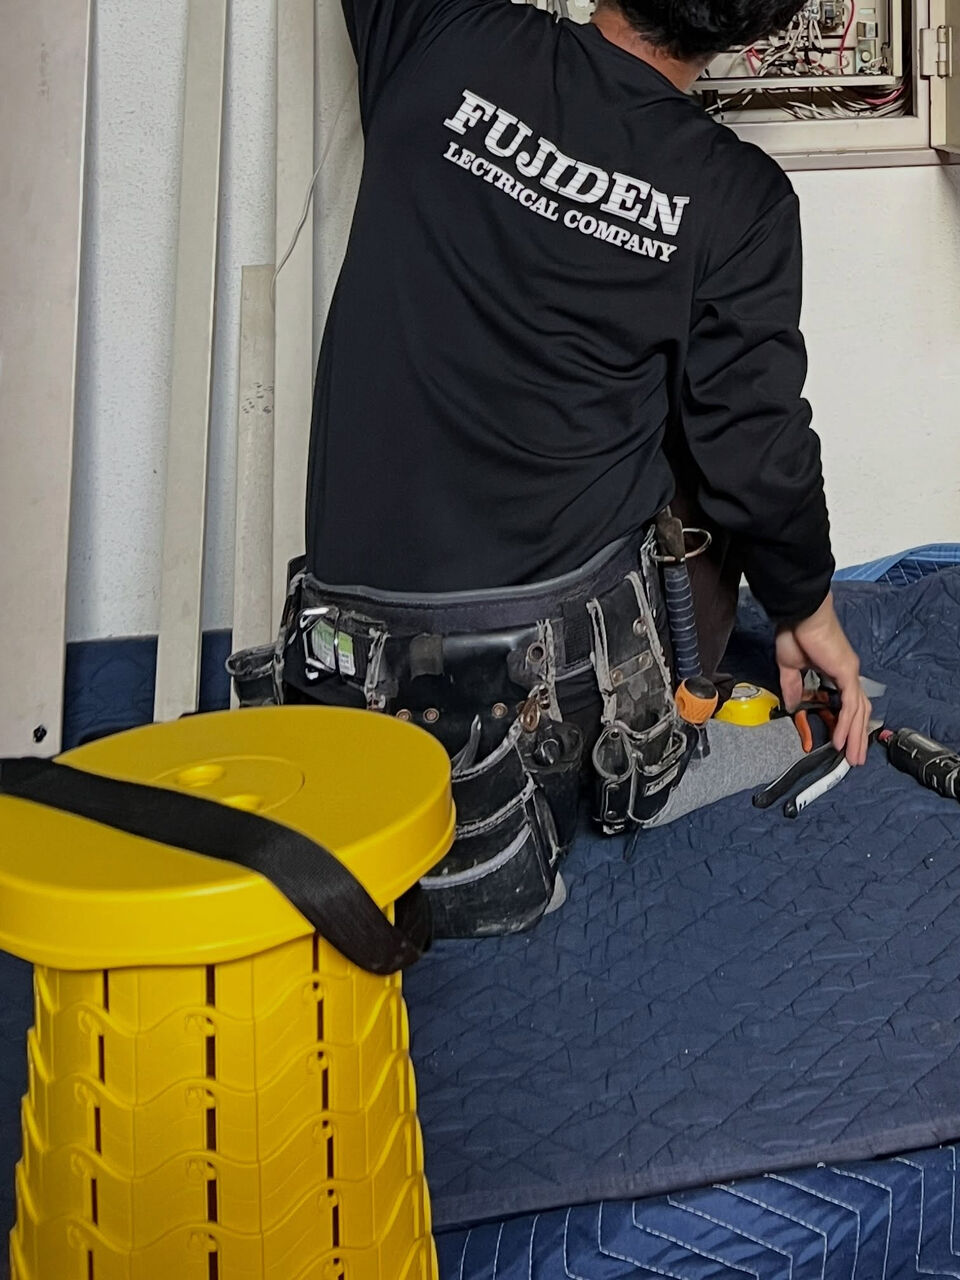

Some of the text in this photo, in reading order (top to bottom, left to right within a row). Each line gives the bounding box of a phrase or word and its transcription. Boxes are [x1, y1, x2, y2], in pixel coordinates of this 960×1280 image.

[443, 89, 690, 236] FUJIDEN
[443, 141, 678, 263] LECTRICAL COMPANY
